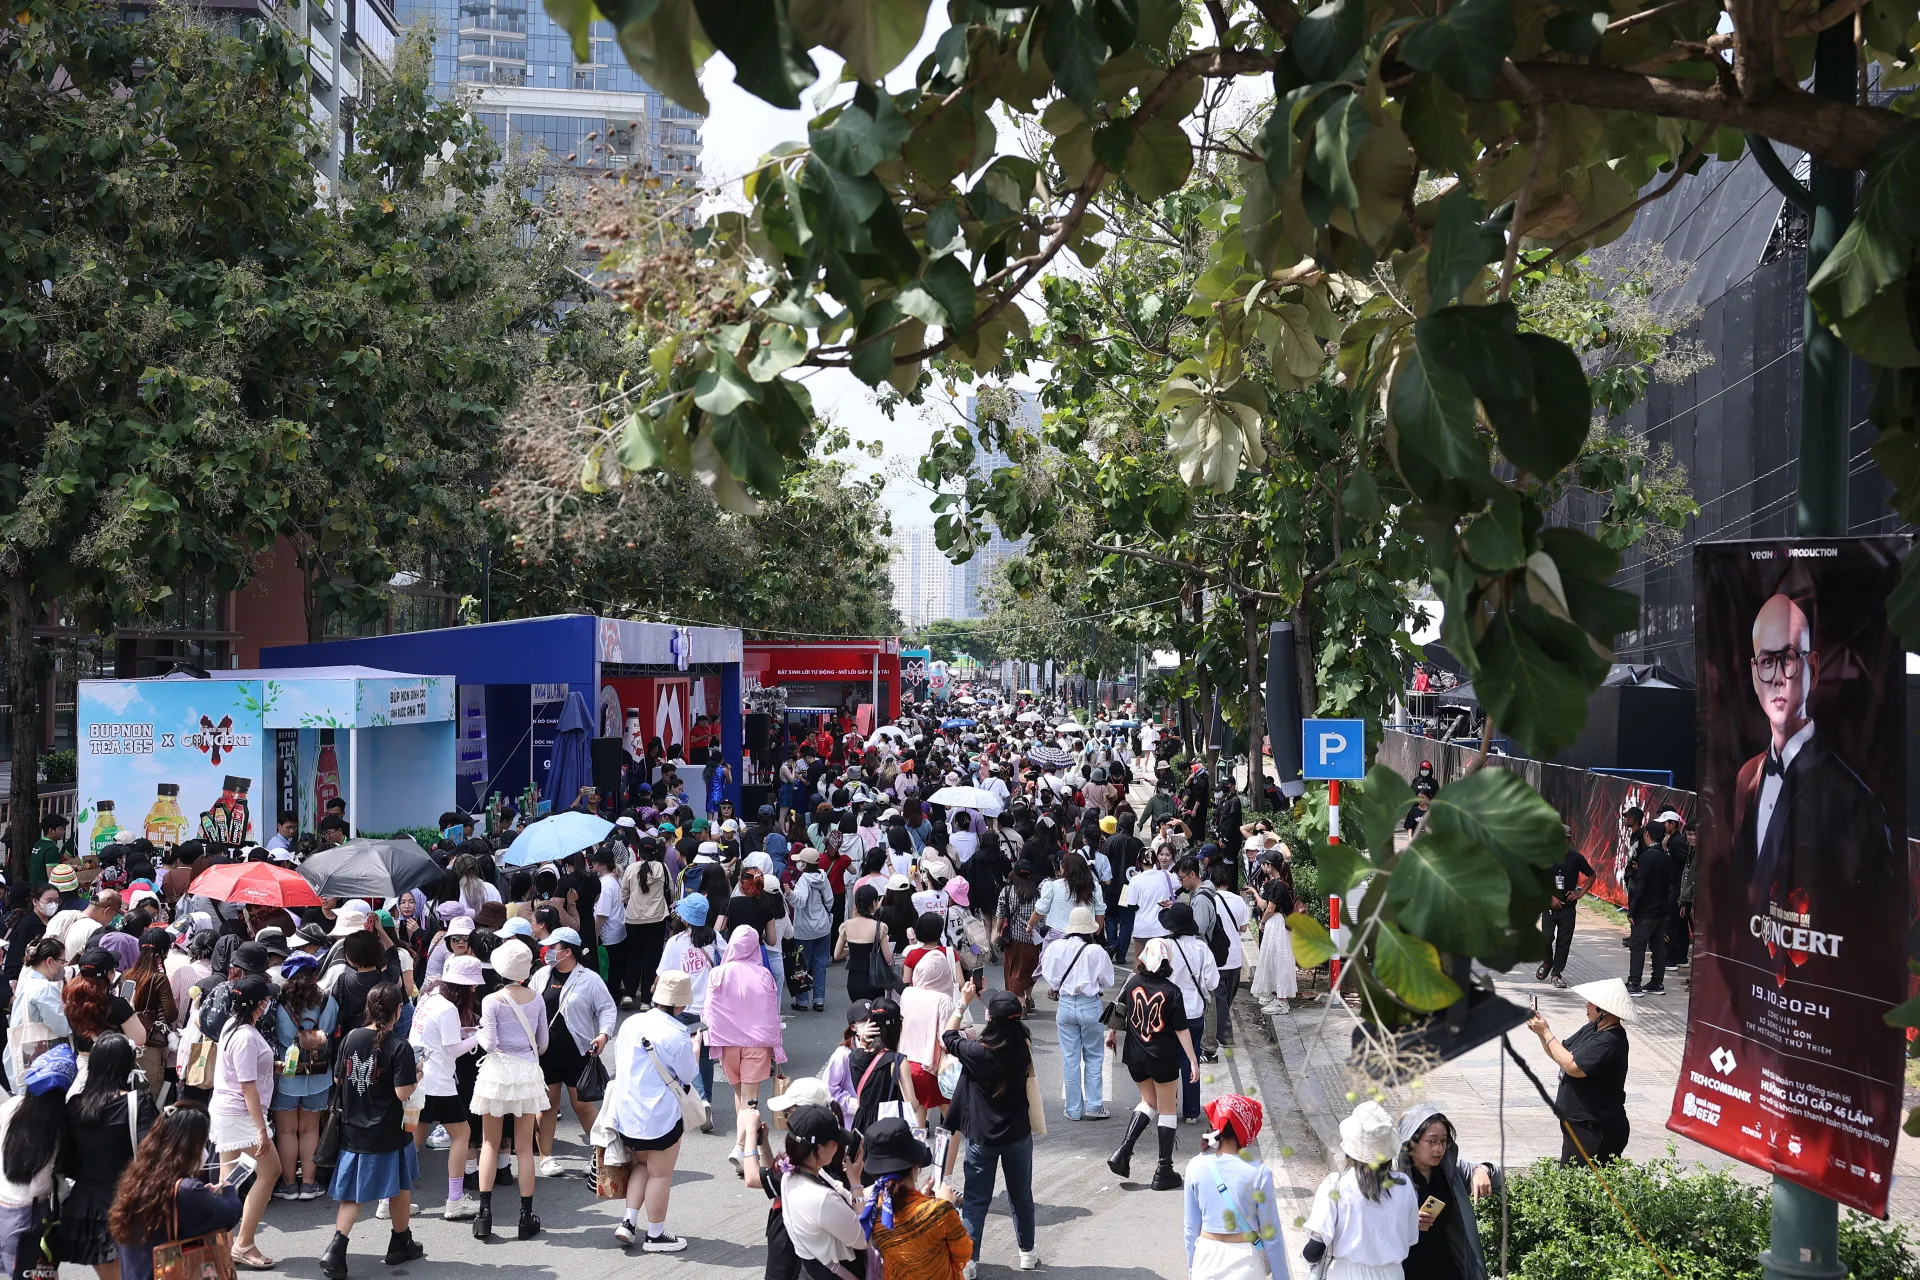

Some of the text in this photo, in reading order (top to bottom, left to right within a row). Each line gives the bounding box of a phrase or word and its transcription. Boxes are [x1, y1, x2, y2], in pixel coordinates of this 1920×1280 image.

[89, 724, 154, 738] BUPNON
[89, 739, 154, 754] TEA 365
[278, 740, 297, 759] TEA
[1319, 733, 1347, 765] P
[1751, 983, 1830, 1020] 19.10.2024
[1690, 1070, 1752, 1104] TECHCOMBANK
[1789, 1090, 1808, 1107] LỜI
[1810, 1096, 1833, 1113] GẤP
[1834, 1105, 1846, 1119] 46
